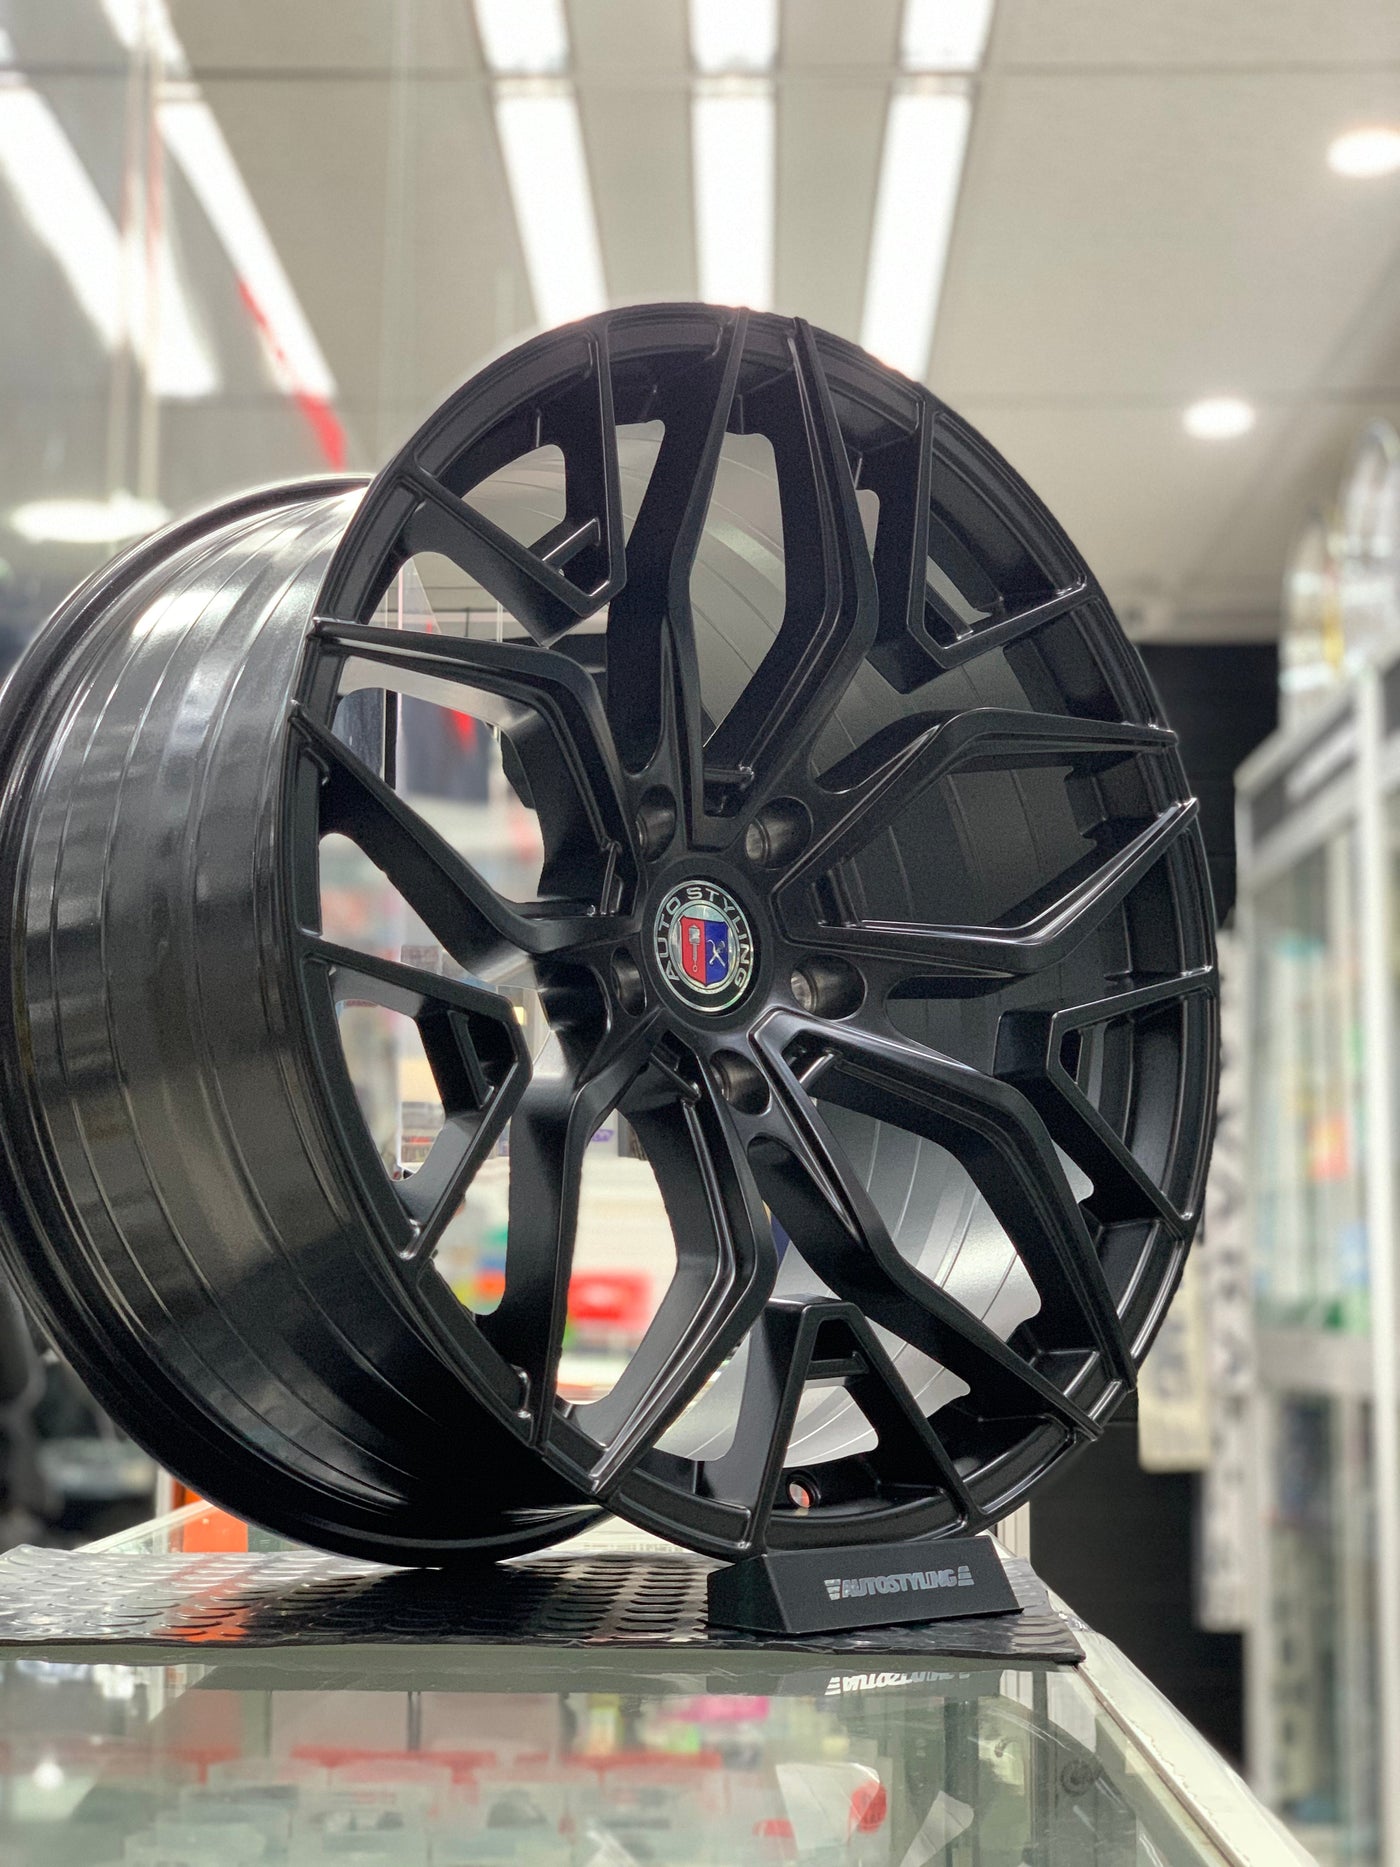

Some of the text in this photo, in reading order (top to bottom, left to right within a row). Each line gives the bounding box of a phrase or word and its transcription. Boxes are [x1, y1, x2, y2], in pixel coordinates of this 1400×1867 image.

[657, 887, 750, 987] AUTO STYLING
[841, 1568, 957, 1598] AUTOSTYLING
